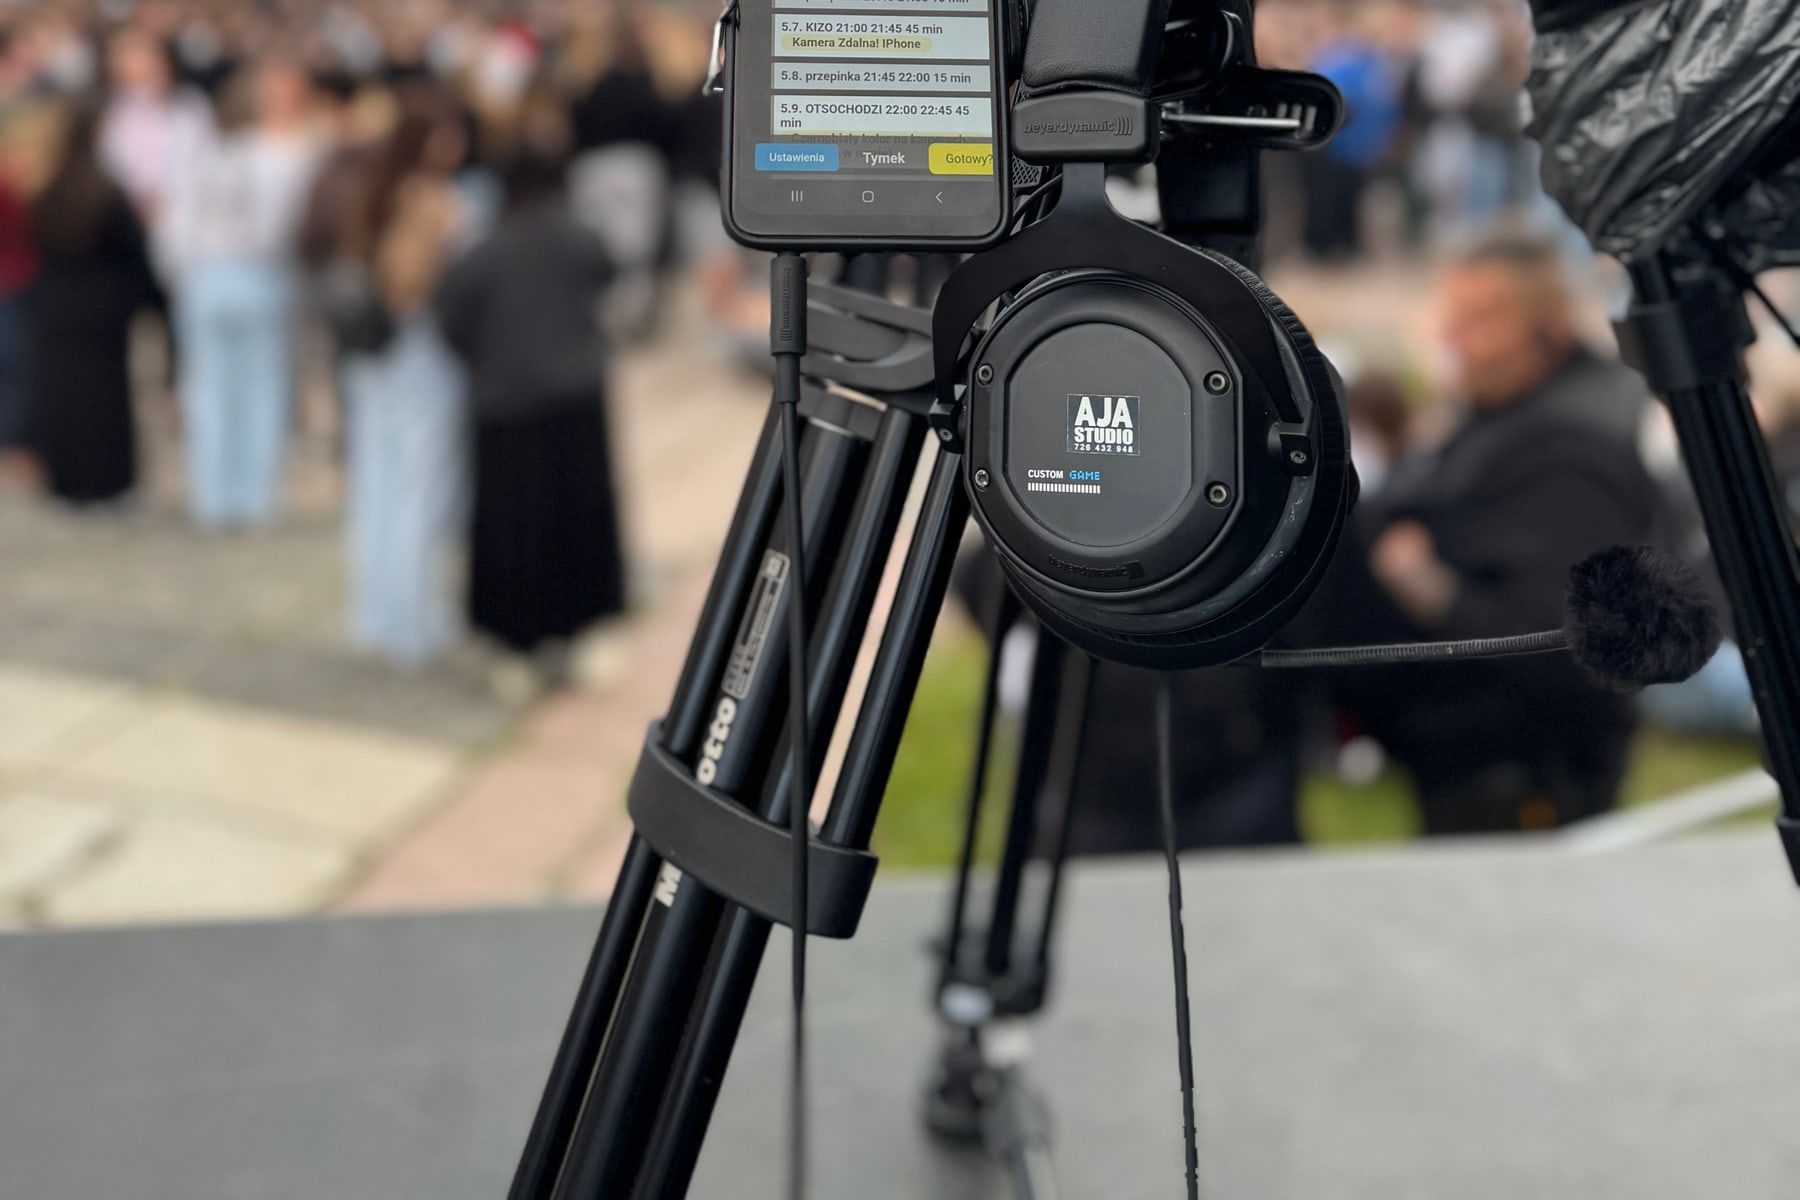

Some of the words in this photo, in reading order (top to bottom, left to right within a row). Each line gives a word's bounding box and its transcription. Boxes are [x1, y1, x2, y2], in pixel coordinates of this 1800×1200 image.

[782, 23, 802, 32] 5.7.
[806, 23, 833, 32] KIZO
[836, 23, 867, 32] 21:00
[871, 24, 902, 33] 21:45
[906, 25, 919, 33] 45
[922, 24, 943, 34] min
[792, 37, 835, 47] Kamera
[838, 38, 879, 48] Zdalna!
[883, 39, 921, 49] IPhone
[781, 71, 802, 80] 5.8.
[806, 71, 861, 83] przepinka
[864, 73, 895, 82] 21:45
[899, 73, 930, 83] 22:00
[934, 73, 947, 83] 15
[950, 73, 971, 83] min
[781, 104, 802, 114] 5.9.
[806, 104, 882, 114] OTSOCHODZI
[886, 105, 917, 115] 22:00
[920, 106, 952, 115] 22:45
[955, 106, 969, 115] 45
[780, 118, 801, 128] min
[1023, 119, 1115, 135] beyerdynamic
[769, 153, 825, 162] Ustawienia
[863, 152, 905, 166] Tymek
[946, 153, 993, 166] Gotowy?
[1074, 397, 1133, 428] AJA
[1074, 427, 1133, 445] STUDIO
[1028, 470, 1063, 479] CUSTOM
[1069, 471, 1100, 480] GAME
